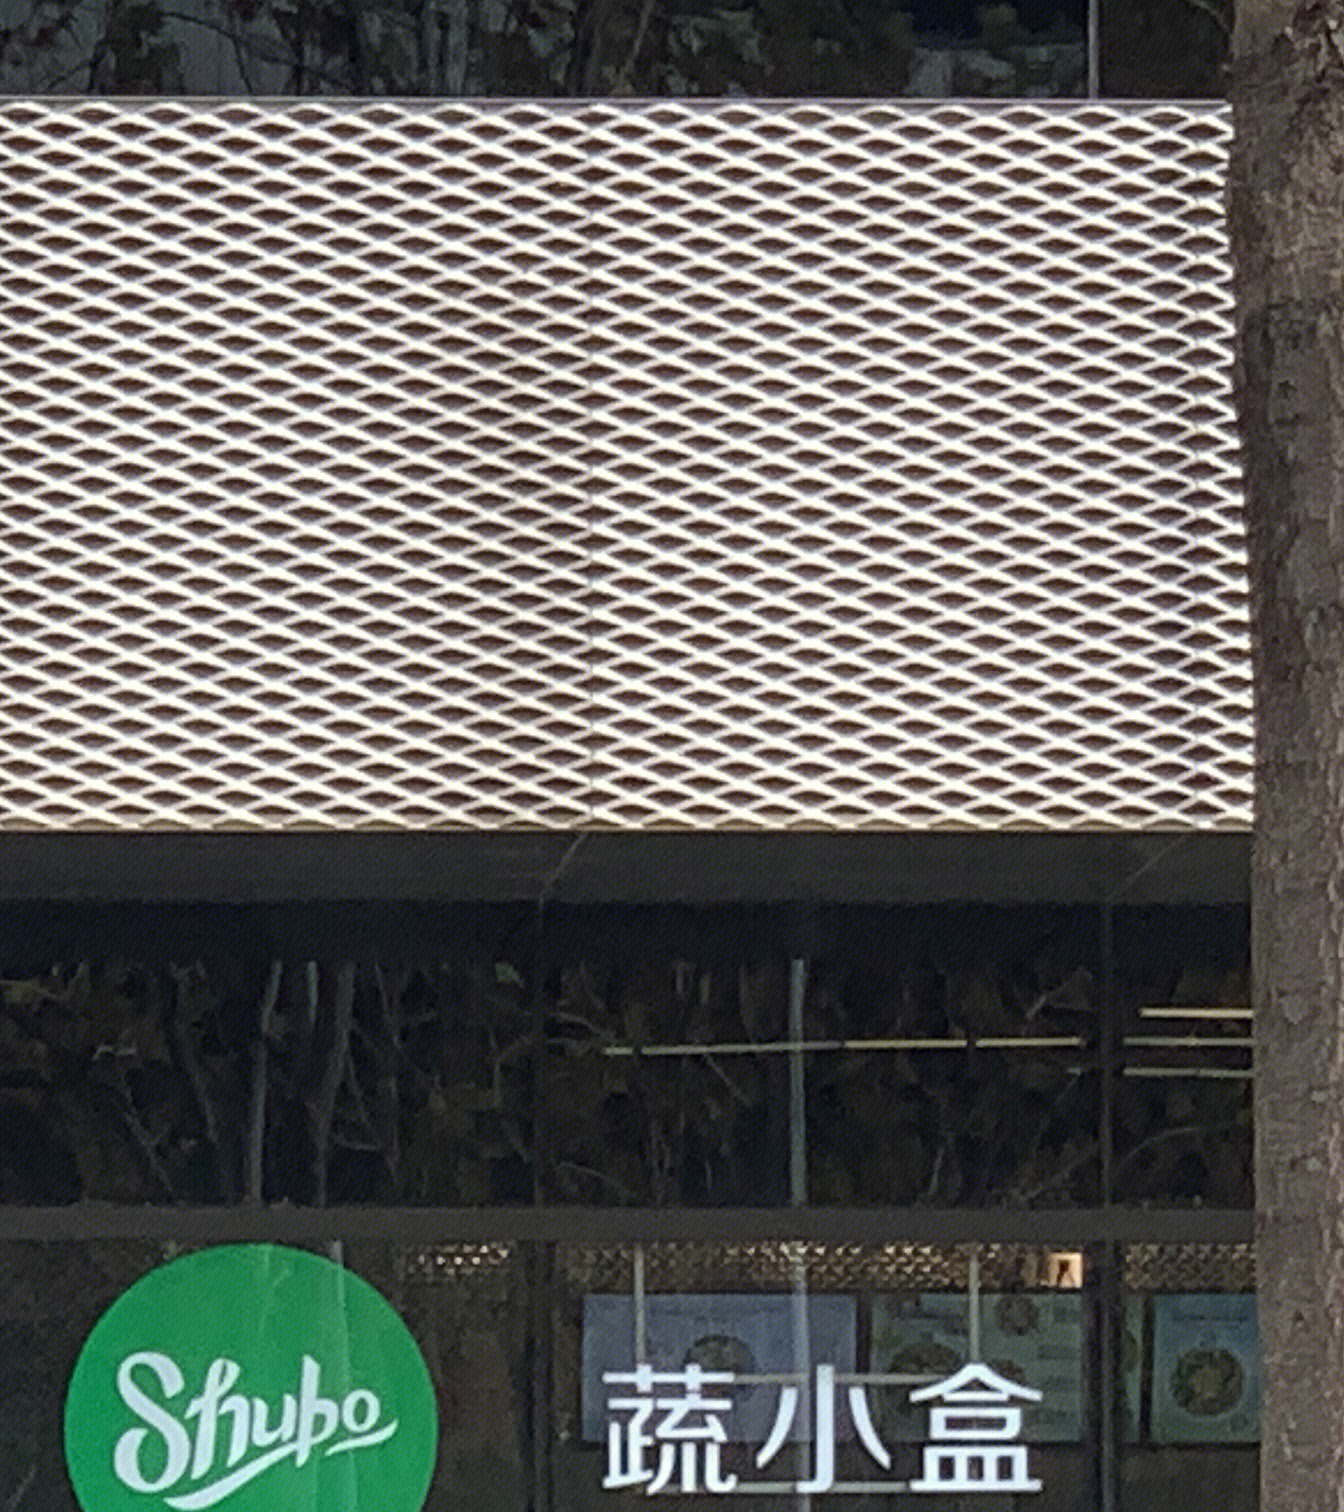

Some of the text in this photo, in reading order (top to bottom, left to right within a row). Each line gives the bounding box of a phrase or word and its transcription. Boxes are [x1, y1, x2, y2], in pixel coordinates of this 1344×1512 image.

[114, 1351, 399, 1511] Shubo
[602, 1364, 1043, 1494] 蔬小盒
